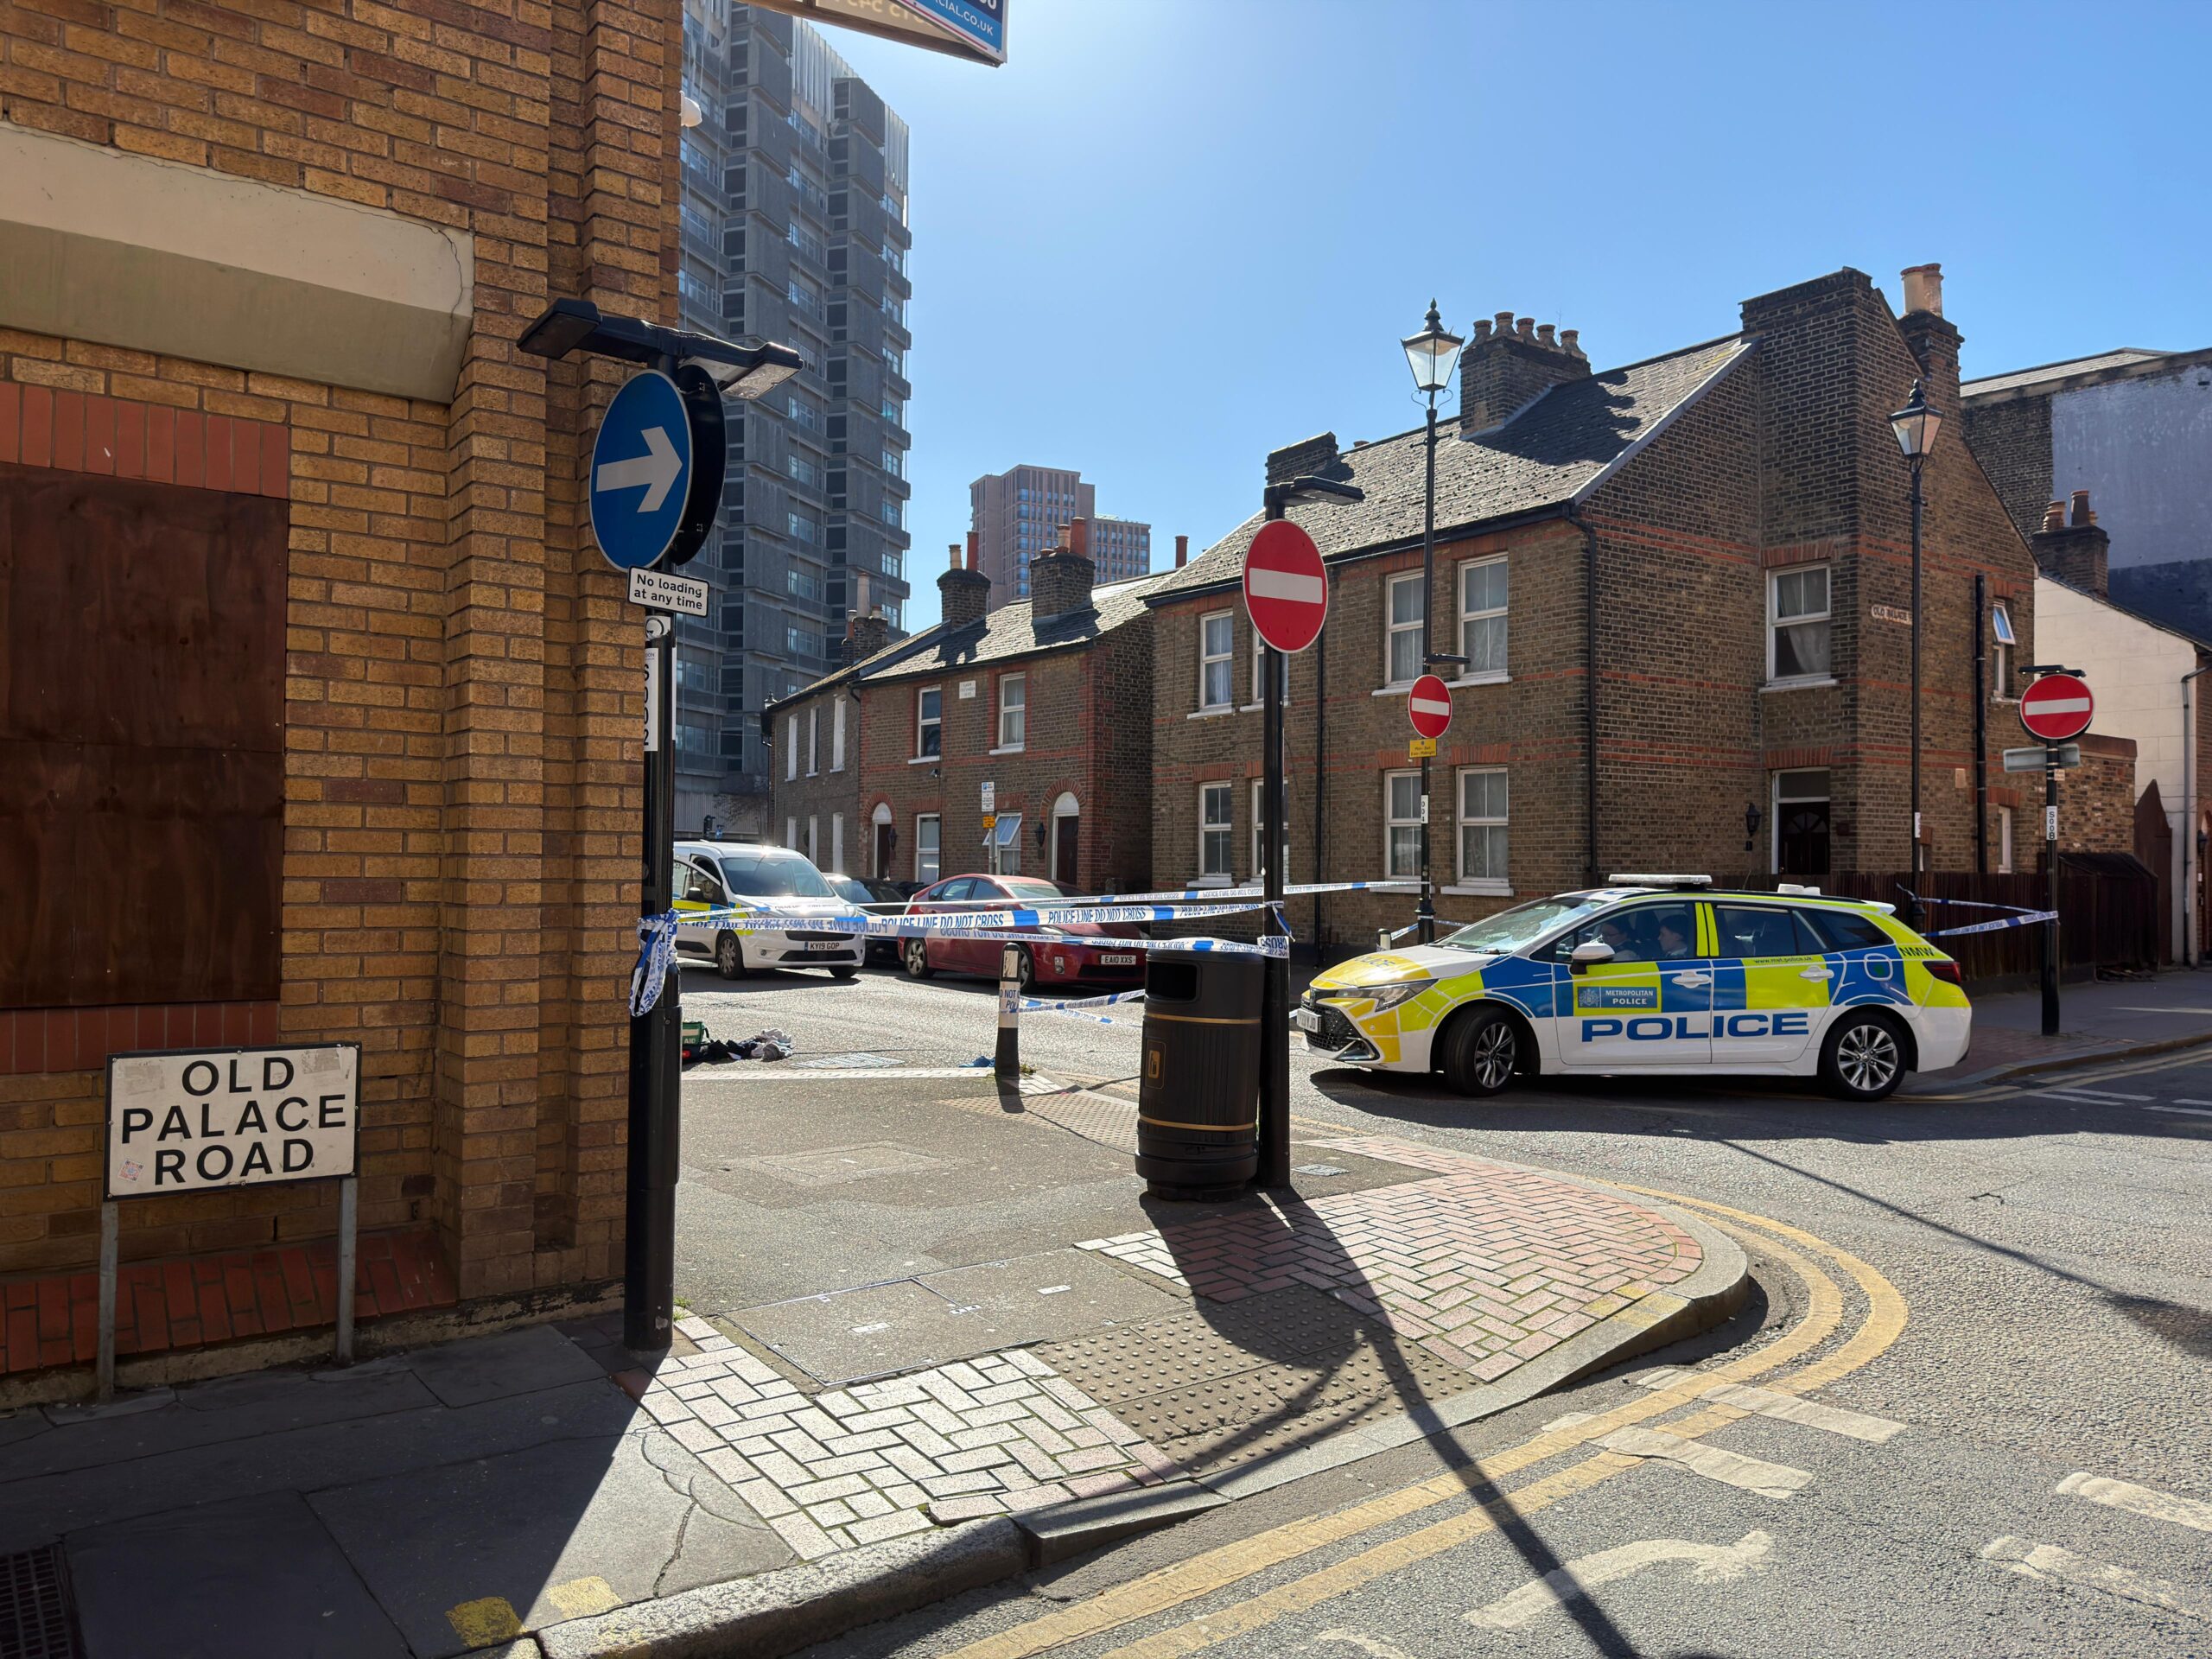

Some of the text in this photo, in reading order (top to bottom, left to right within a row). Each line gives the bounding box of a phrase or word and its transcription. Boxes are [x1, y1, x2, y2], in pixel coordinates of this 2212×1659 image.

[936, 0, 994, 36] CIAL.CO.UK
[633, 588, 703, 610] at any time
[637, 574, 702, 599] No loading
[917, 916, 938, 928] LINE
[940, 915, 953, 928] DO
[955, 914, 973, 928] NOT
[976, 913, 1004, 927] CROSS
[1048, 907, 1147, 924] POLICE LINE DO NOT CROSS
[1898, 947, 1935, 957] NMW
[1005, 989, 1016, 998] NOT
[1580, 1013, 1809, 1043] POLICE
[181, 1057, 295, 1096] OLD
[121, 1093, 346, 1144] PALACE
[154, 1138, 315, 1185] ROAD
